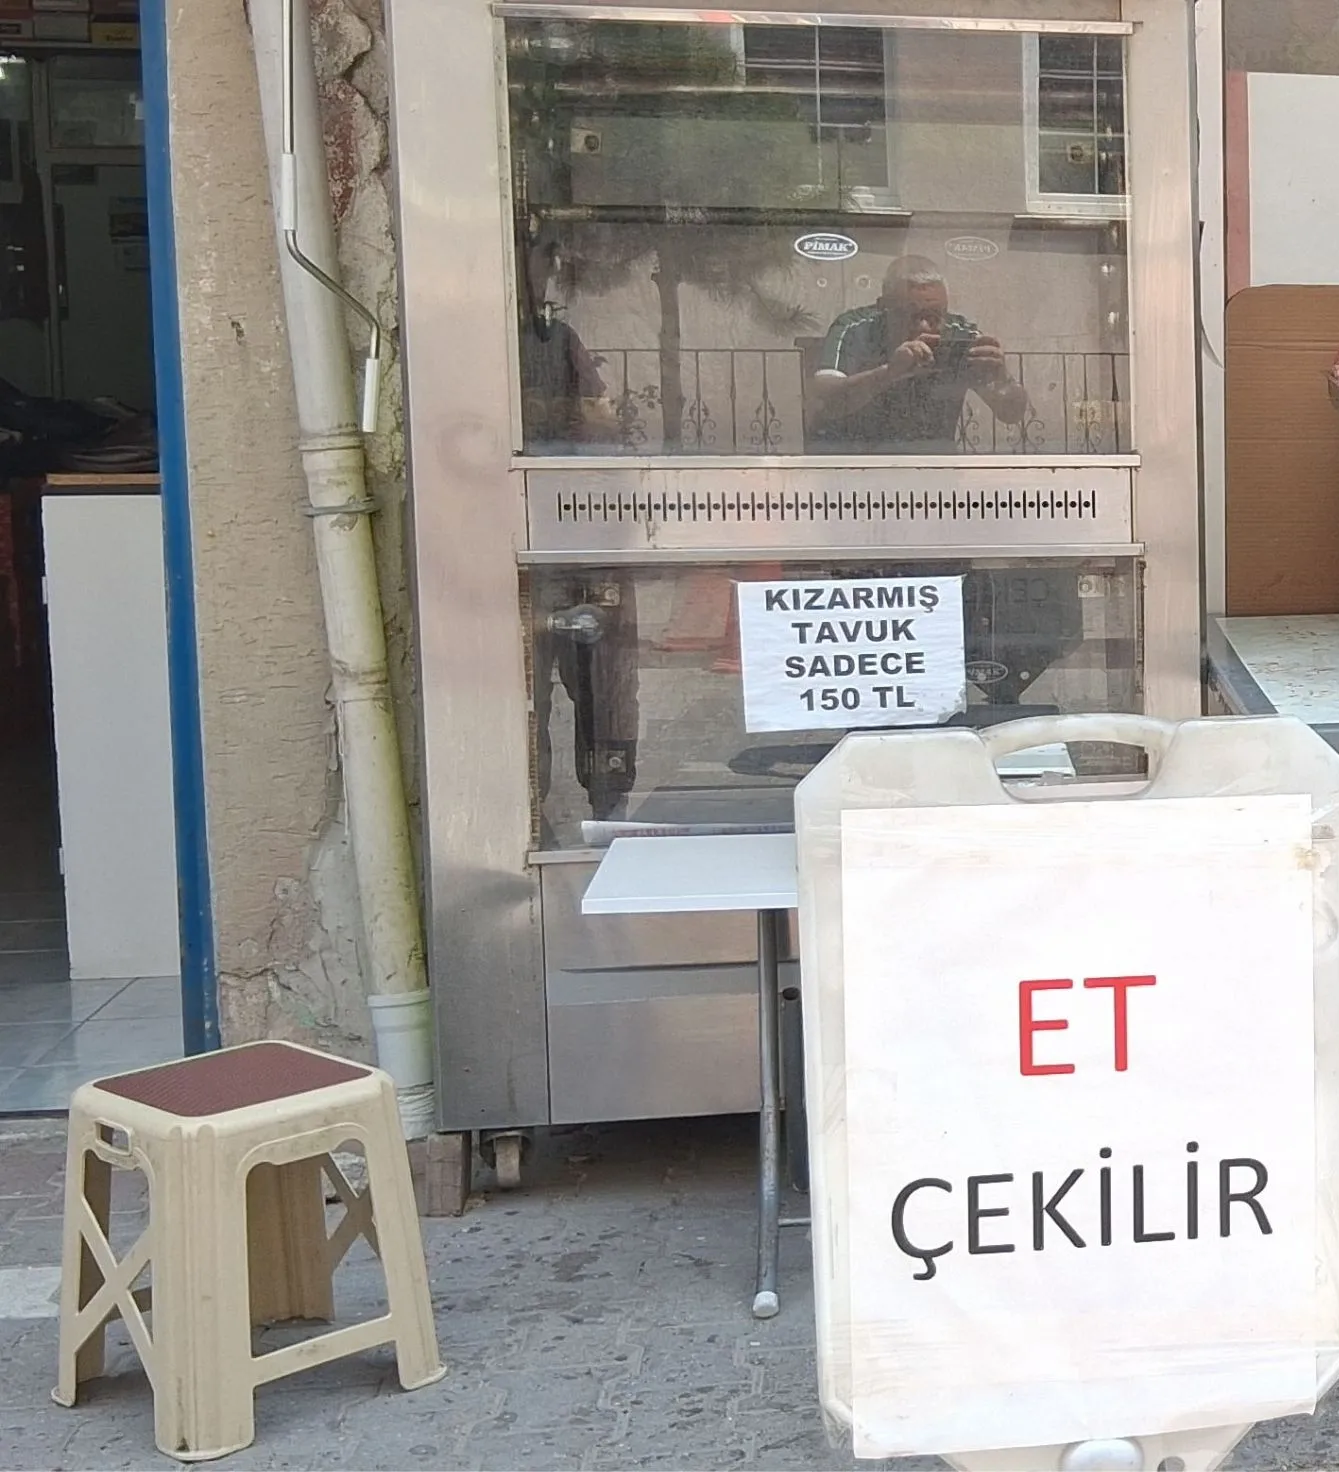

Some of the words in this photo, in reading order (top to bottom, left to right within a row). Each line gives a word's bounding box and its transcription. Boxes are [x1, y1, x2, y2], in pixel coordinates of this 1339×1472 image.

[764, 585, 939, 613] KIZARMIŞ
[791, 618, 916, 644] TAVUK
[784, 651, 926, 678] SADECE
[799, 687, 861, 711] 150
[872, 685, 915, 708] TL
[1018, 974, 1157, 1076] ET
[891, 1140, 1274, 1281] ÇEKİLİR
